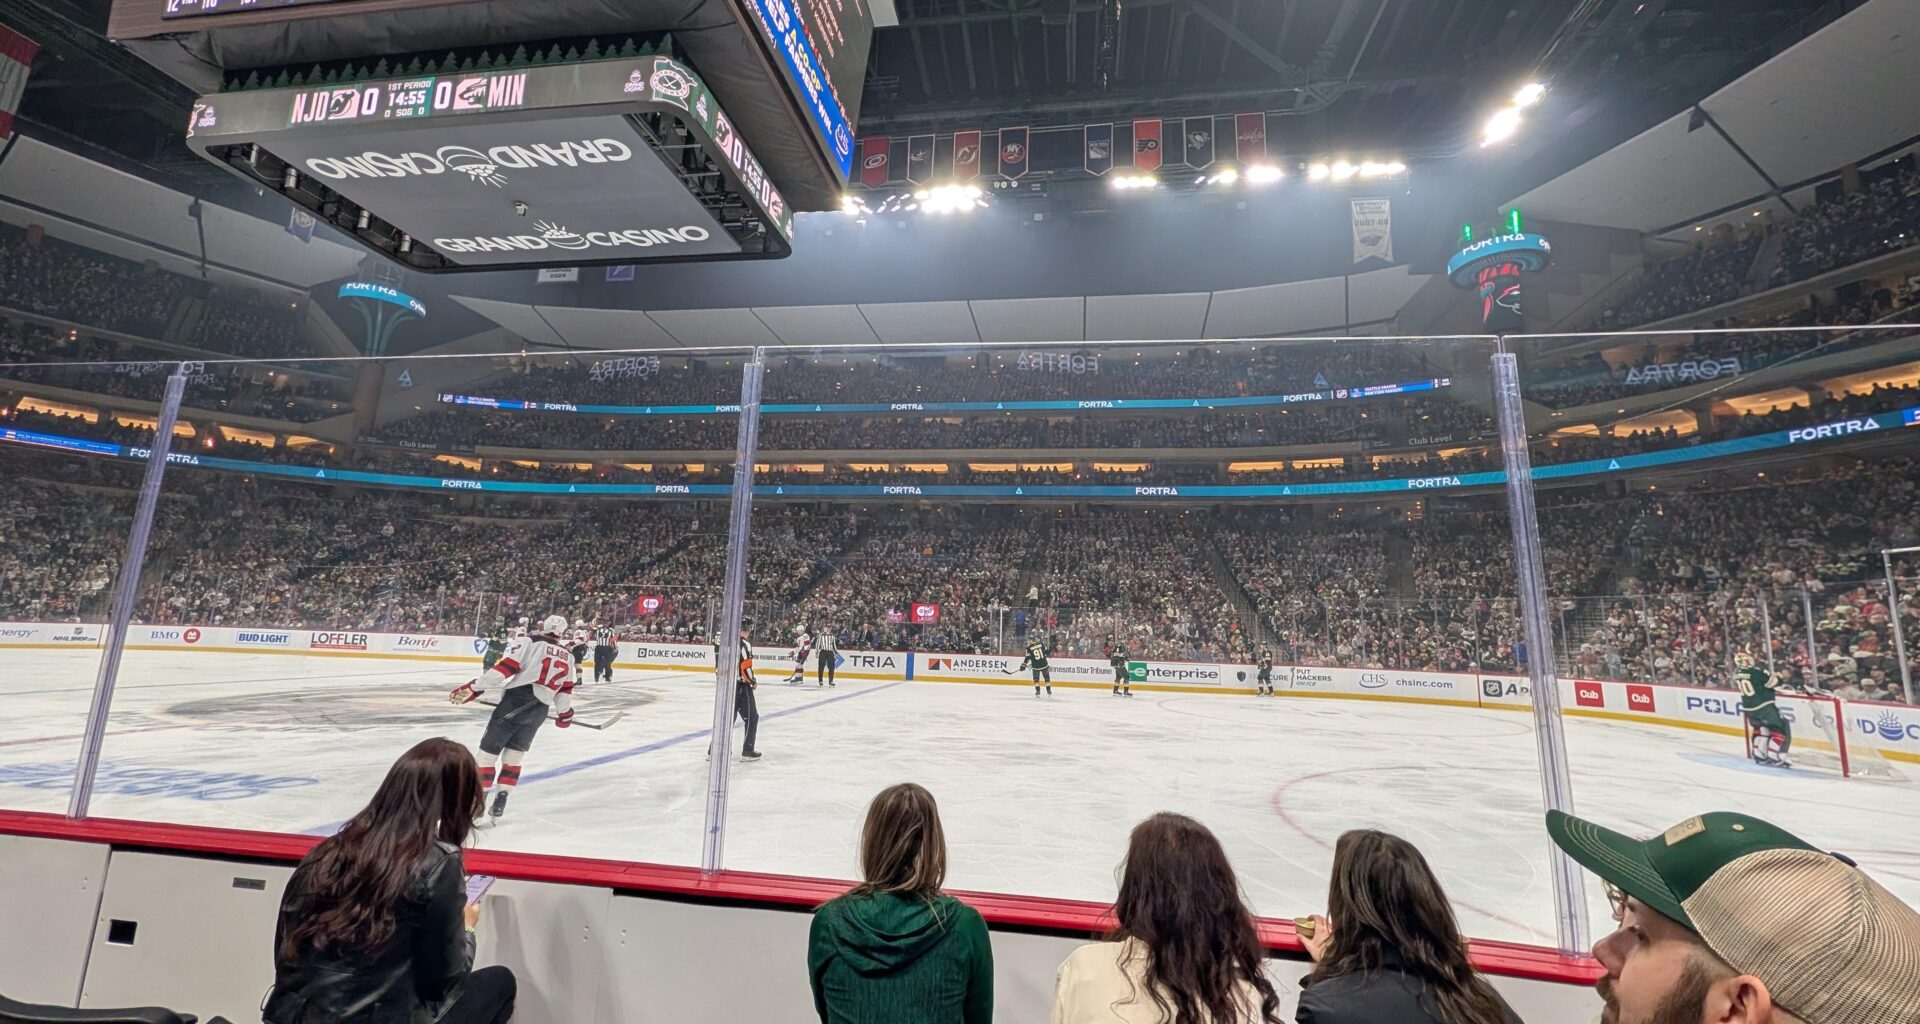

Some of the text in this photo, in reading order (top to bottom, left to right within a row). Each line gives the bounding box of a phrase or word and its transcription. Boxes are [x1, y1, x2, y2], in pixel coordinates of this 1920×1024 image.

[388, 79, 431, 91] 1ST PERIOD
[487, 74, 527, 108] MIN
[388, 90, 426, 107] 14:55
[434, 81, 452, 110] 0
[291, 91, 328, 124] NJD
[361, 88, 379, 116] 0
[418, 106, 424, 115] 0
[488, 138, 632, 169] GRAND
[733, 138, 742, 169] 0
[305, 151, 445, 179] CASINO
[744, 158, 762, 190] 14:55
[762, 178, 770, 207] 0
[586, 225, 710, 248] CASINO
[433, 234, 549, 253] GRAND
[1283, 392, 1322, 402] FORTRA
[544, 403, 577, 412] FORTRA
[891, 403, 923, 411] FORTRA
[1079, 401, 1113, 409] FORTRA
[1788, 417, 1880, 444] FORTRA
[1408, 434, 1453, 445] Club Level
[442, 479, 482, 489] FORTRA
[1408, 476, 1461, 488] FORTRA
[655, 485, 690, 494] FORTRA
[883, 486, 922, 494] FORTRA
[1135, 487, 1178, 495] FORTRA
[151, 630, 180, 640] BMO
[239, 633, 288, 644] BUD LIGHT
[311, 632, 367, 646] LOFFLER
[398, 636, 439, 648] Bonfe
[546, 645, 569, 661] GLASS
[648, 649, 670, 658] DUKE
[670, 650, 706, 659] CANNON
[1033, 649, 1044, 660] 91
[850, 654, 896, 668] TRIA
[953, 659, 1008, 669] ANDERSEN
[536, 657, 570, 691] 12
[1076, 666, 1090, 674] Star
[1090, 666, 1112, 675] Tribune
[1130, 667, 1218, 680] enterprise
[1362, 673, 1386, 684] CHS
[1395, 678, 1453, 689] chsinc.com
[1579, 689, 1599, 699] Cub
[1631, 693, 1650, 704] Cub
